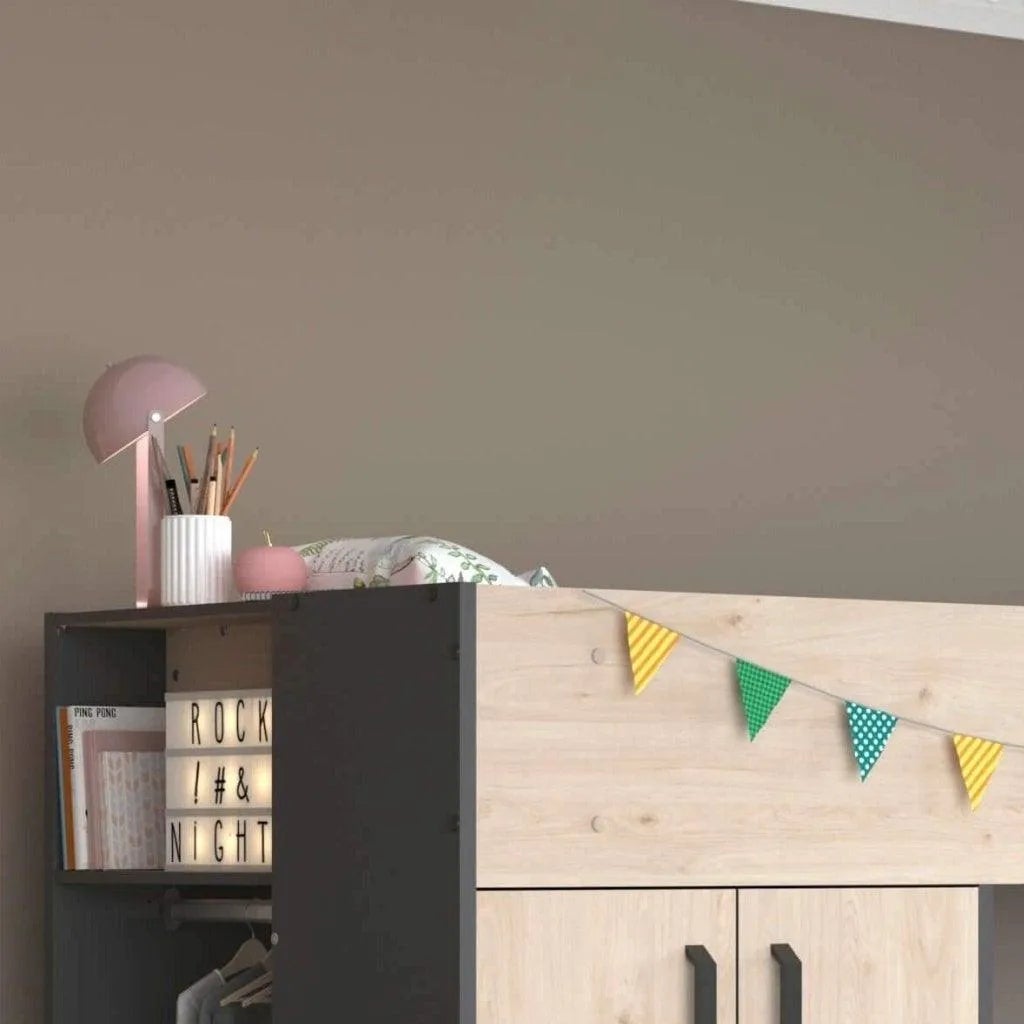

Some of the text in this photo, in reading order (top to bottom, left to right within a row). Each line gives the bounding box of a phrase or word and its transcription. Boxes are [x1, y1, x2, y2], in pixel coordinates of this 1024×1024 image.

[73, 707, 117, 718] PING PONG
[191, 699, 269, 745] ROCK
